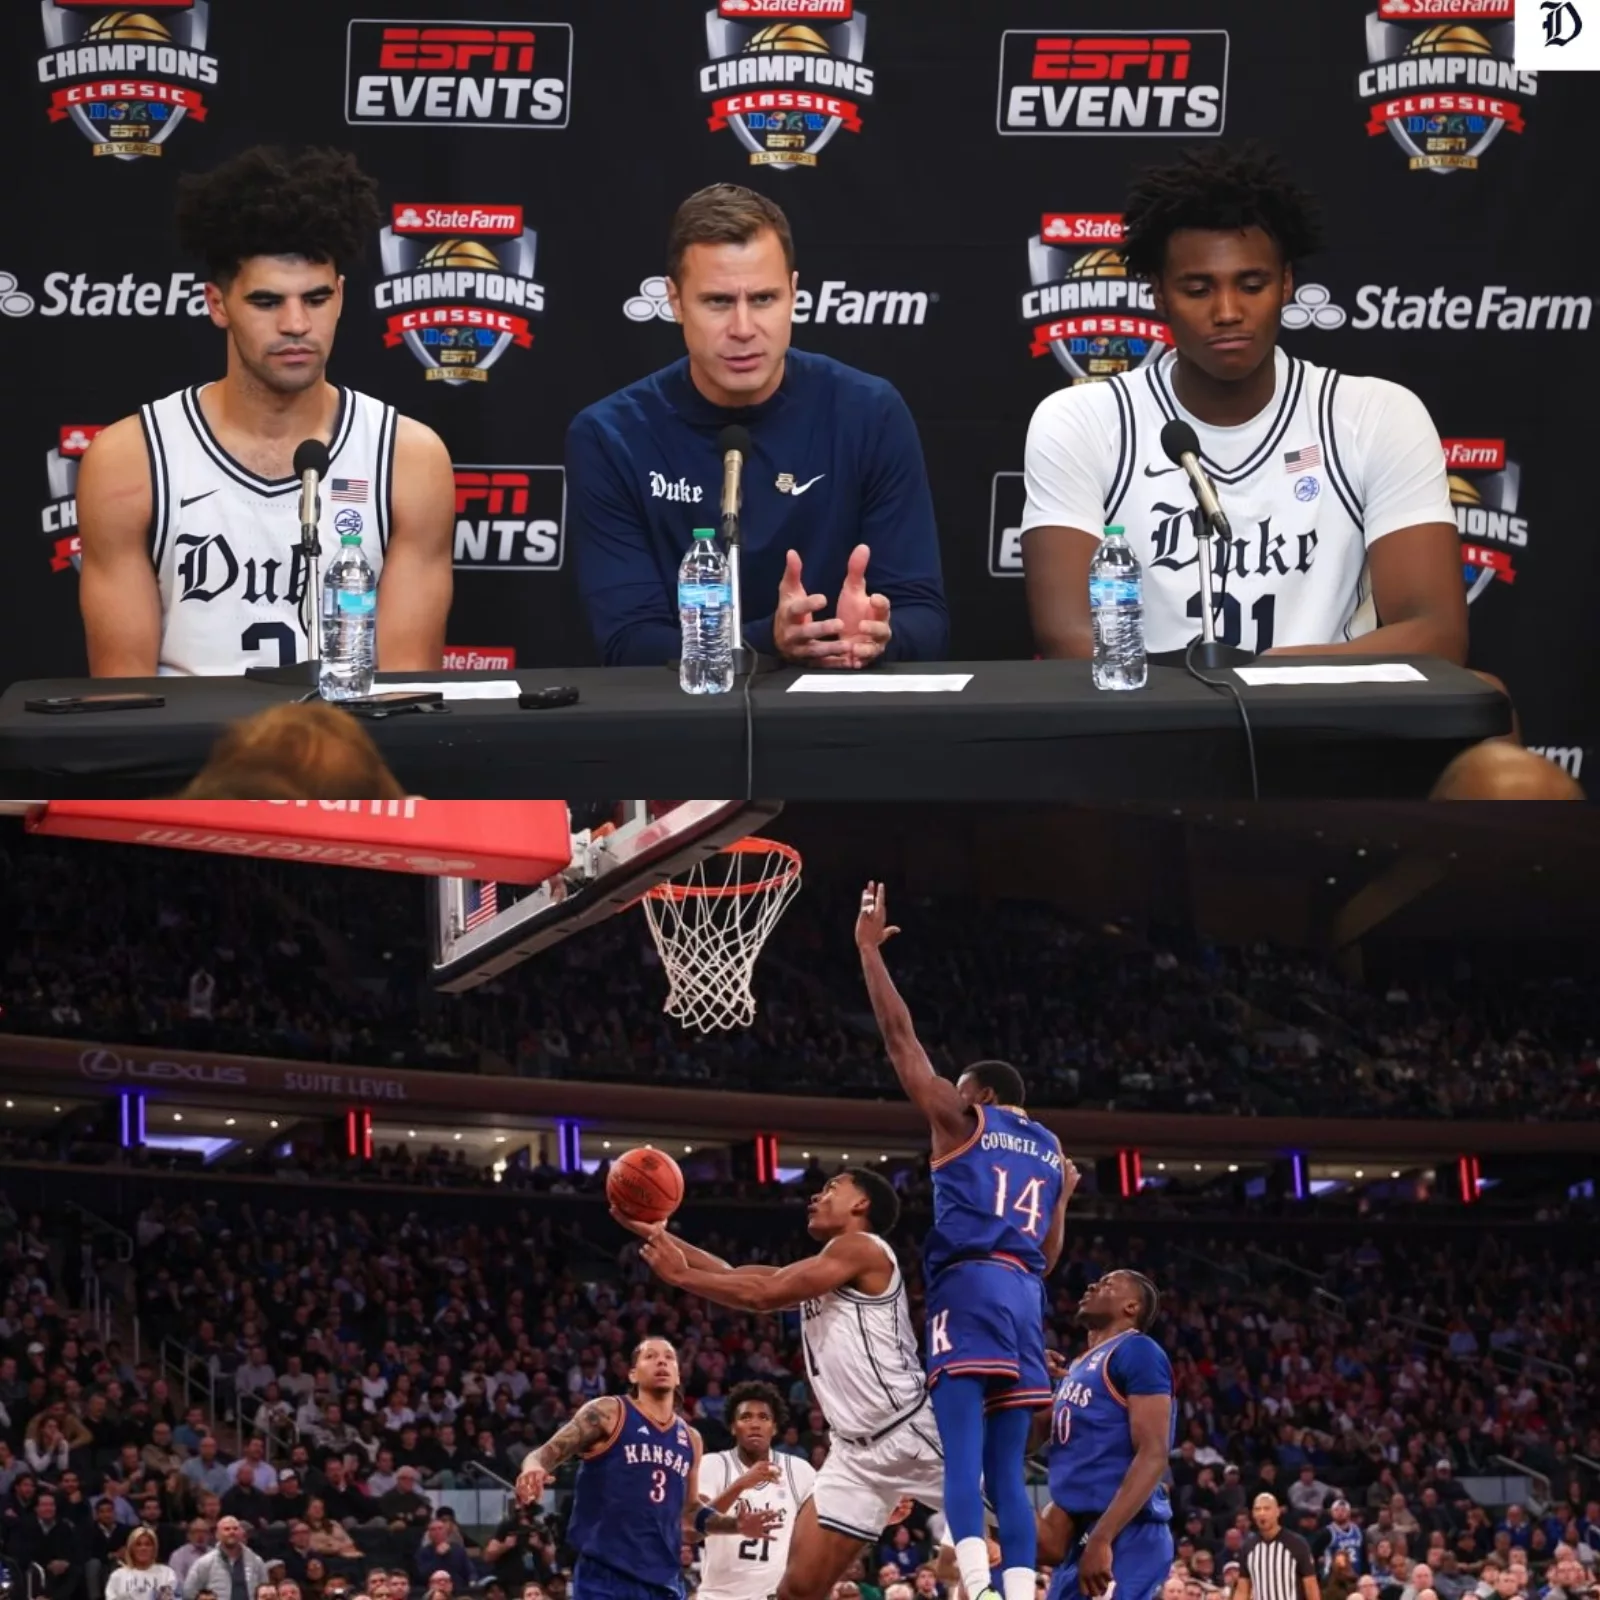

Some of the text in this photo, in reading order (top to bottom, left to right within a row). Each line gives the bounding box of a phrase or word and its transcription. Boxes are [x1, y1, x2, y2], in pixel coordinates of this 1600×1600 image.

[37, 44, 218, 84] CHAMPIONS
[379, 28, 535, 72] ESPN
[1032, 38, 1192, 80] ESPN
[67, 83, 185, 103] CLASSIC
[700, 55, 874, 95] CHAMPIONS
[1358, 56, 1539, 97] CHAMPIONS
[355, 75, 565, 121] EVENTS
[727, 93, 841, 114] CLASSIC
[1007, 85, 1220, 128] EVENTS
[1386, 96, 1504, 116] CLASSIC
[110, 124, 150, 138] ESPN
[766, 134, 805, 148] ESPN
[1426, 137, 1466, 151] ESPN
[424, 209, 515, 229] StateFarm
[1074, 219, 1122, 238] State
[40, 271, 210, 317] StateFa
[374, 271, 545, 312] CHAMPIONS
[791, 280, 929, 326] eFarm
[1022, 281, 1156, 319] CHAMPIO
[1351, 284, 1593, 330] StateFarm
[402, 309, 512, 330] CLASSIC
[1050, 319, 1165, 338] CLASSIC
[441, 349, 476, 363] ESPN
[454, 472, 530, 514] PN
[649, 471, 703, 503] Duke
[453, 519, 559, 562] NTS
[1149, 500, 1319, 579] Duke
[175, 533, 308, 605] Duk
[135, 830, 401, 866] StateFarm
[125, 1060, 247, 1084] LEXUS
[284, 1071, 407, 1099] SUITE LEVEL
[981, 1131, 1038, 1156] COUNCIL
[992, 1164, 1046, 1238] 14
[932, 1309, 953, 1357] K
[624, 1443, 690, 1477] KANSAS
[649, 1469, 667, 1503] 3
